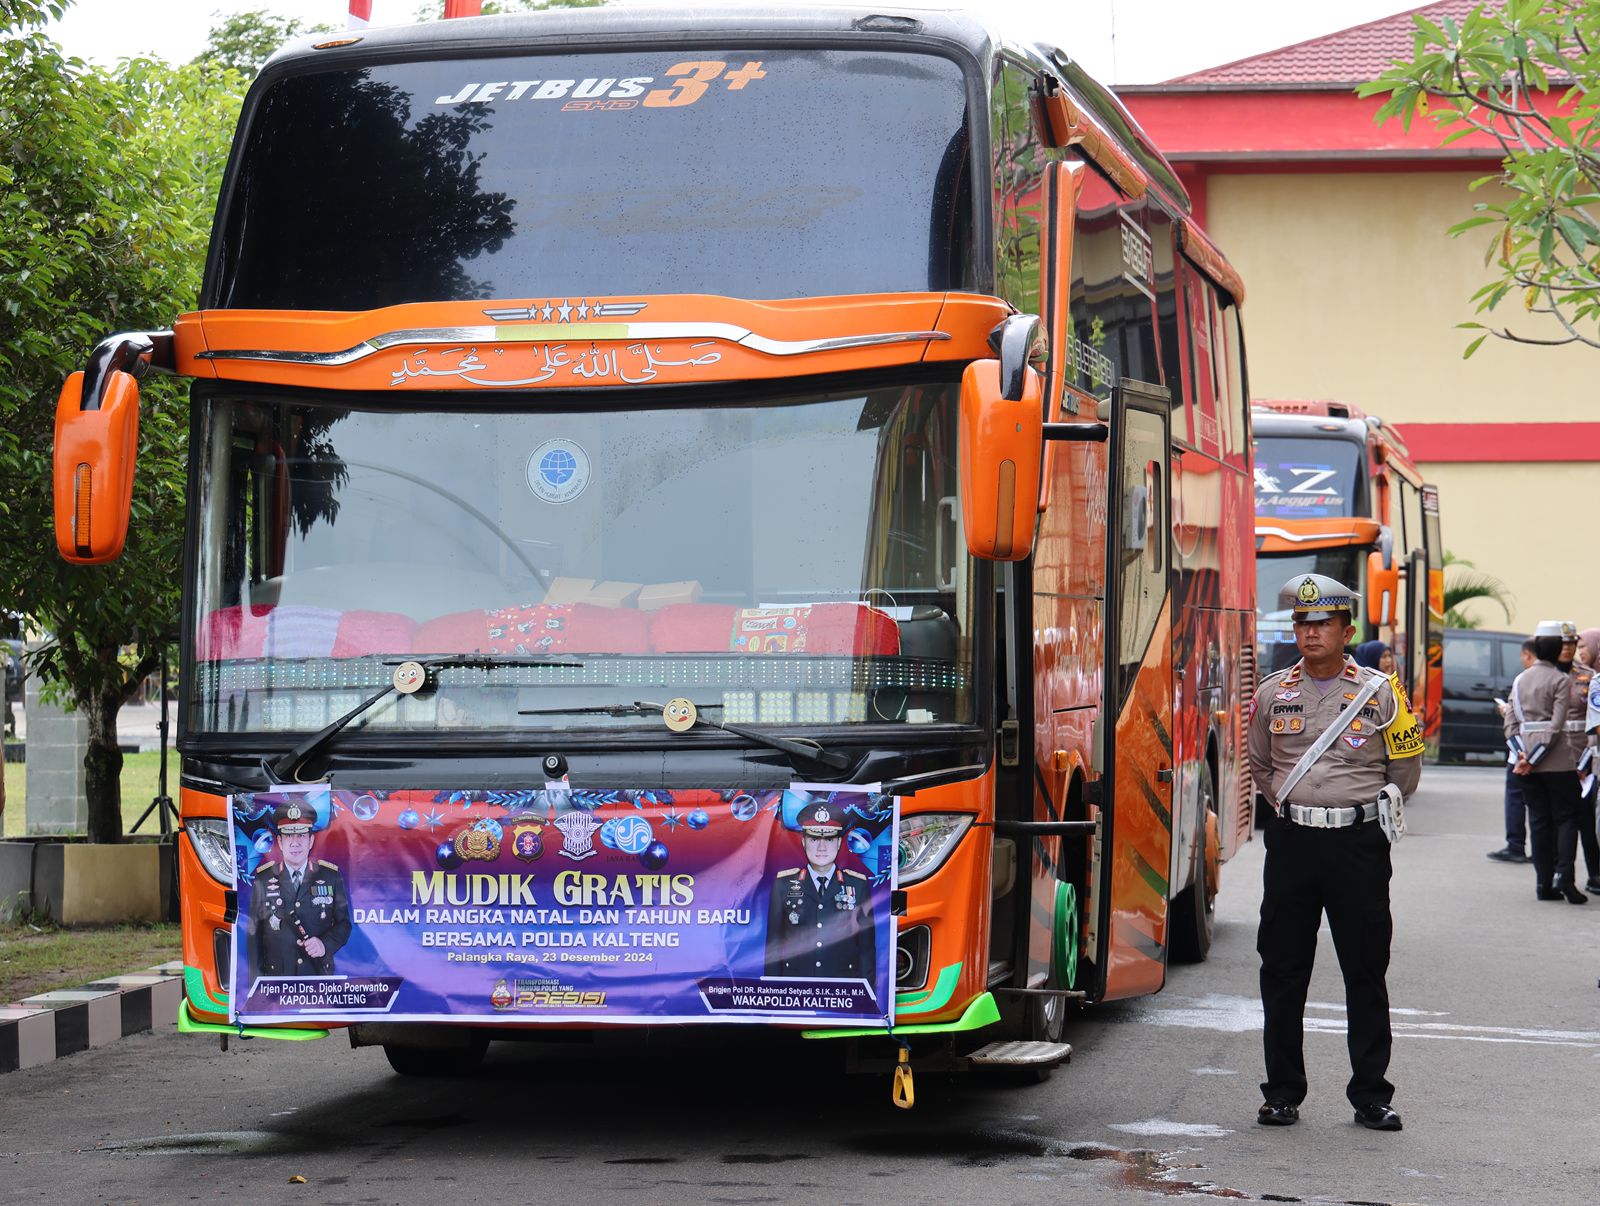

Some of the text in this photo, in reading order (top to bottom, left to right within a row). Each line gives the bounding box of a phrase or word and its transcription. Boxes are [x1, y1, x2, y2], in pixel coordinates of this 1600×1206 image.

[435, 76, 654, 105] JETBUS
[560, 99, 640, 112] SHD
[1273, 704, 1304, 714] ERWIN
[1340, 703, 1374, 718] PRI
[353, 908, 751, 925] DALAM RANGKA NATAL DAN TAHUN BARU
[422, 931, 679, 947] BERSAMA POLDA KALTENG
[447, 952, 653, 964] Palangka Raya, 23 Desember 2024
[260, 982, 389, 996] Irjen Pol Drs. Djoko Poerwanto
[708, 986, 731, 995] Brigjen
[744, 986, 756, 994] DR.
[757, 987, 787, 995] Rakhmad
[789, 987, 814, 996] Setyadi,
[852, 988, 866, 996] M.H.
[279, 994, 366, 1005] KAPOLDA KALTENG
[517, 991, 607, 1005] PRESISI
[732, 995, 853, 1009] WAKAPOLDA KALTENG
